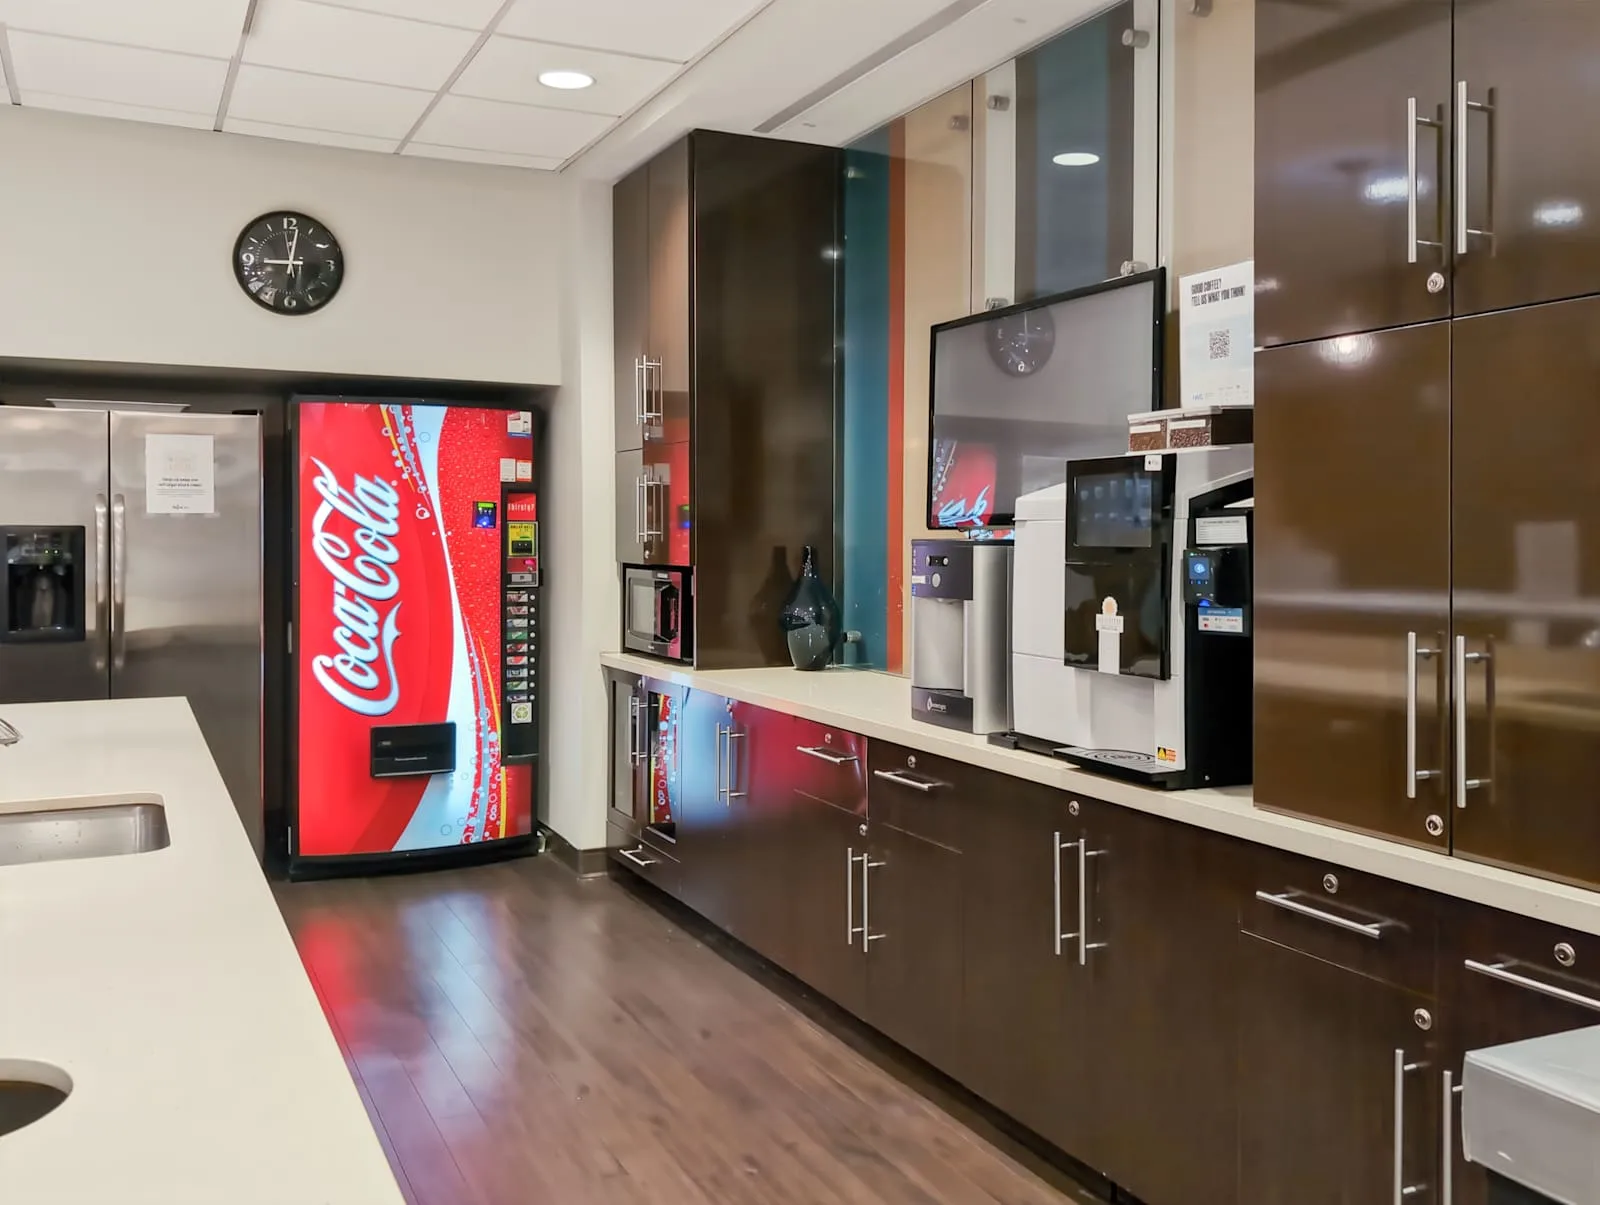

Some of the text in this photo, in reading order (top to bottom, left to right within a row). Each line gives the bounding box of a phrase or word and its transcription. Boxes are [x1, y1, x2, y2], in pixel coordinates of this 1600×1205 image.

[283, 217, 298, 230] 12
[242, 252, 255, 266] 9
[325, 259, 335, 272] 3
[1191, 281, 1203, 294] GOOD
[284, 295, 296, 308] 6
[1201, 294, 1208, 305] US
[1208, 291, 1221, 303] WHAT
[1221, 288, 1230, 301] YOU
[311, 456, 402, 717] Coca-Cola
